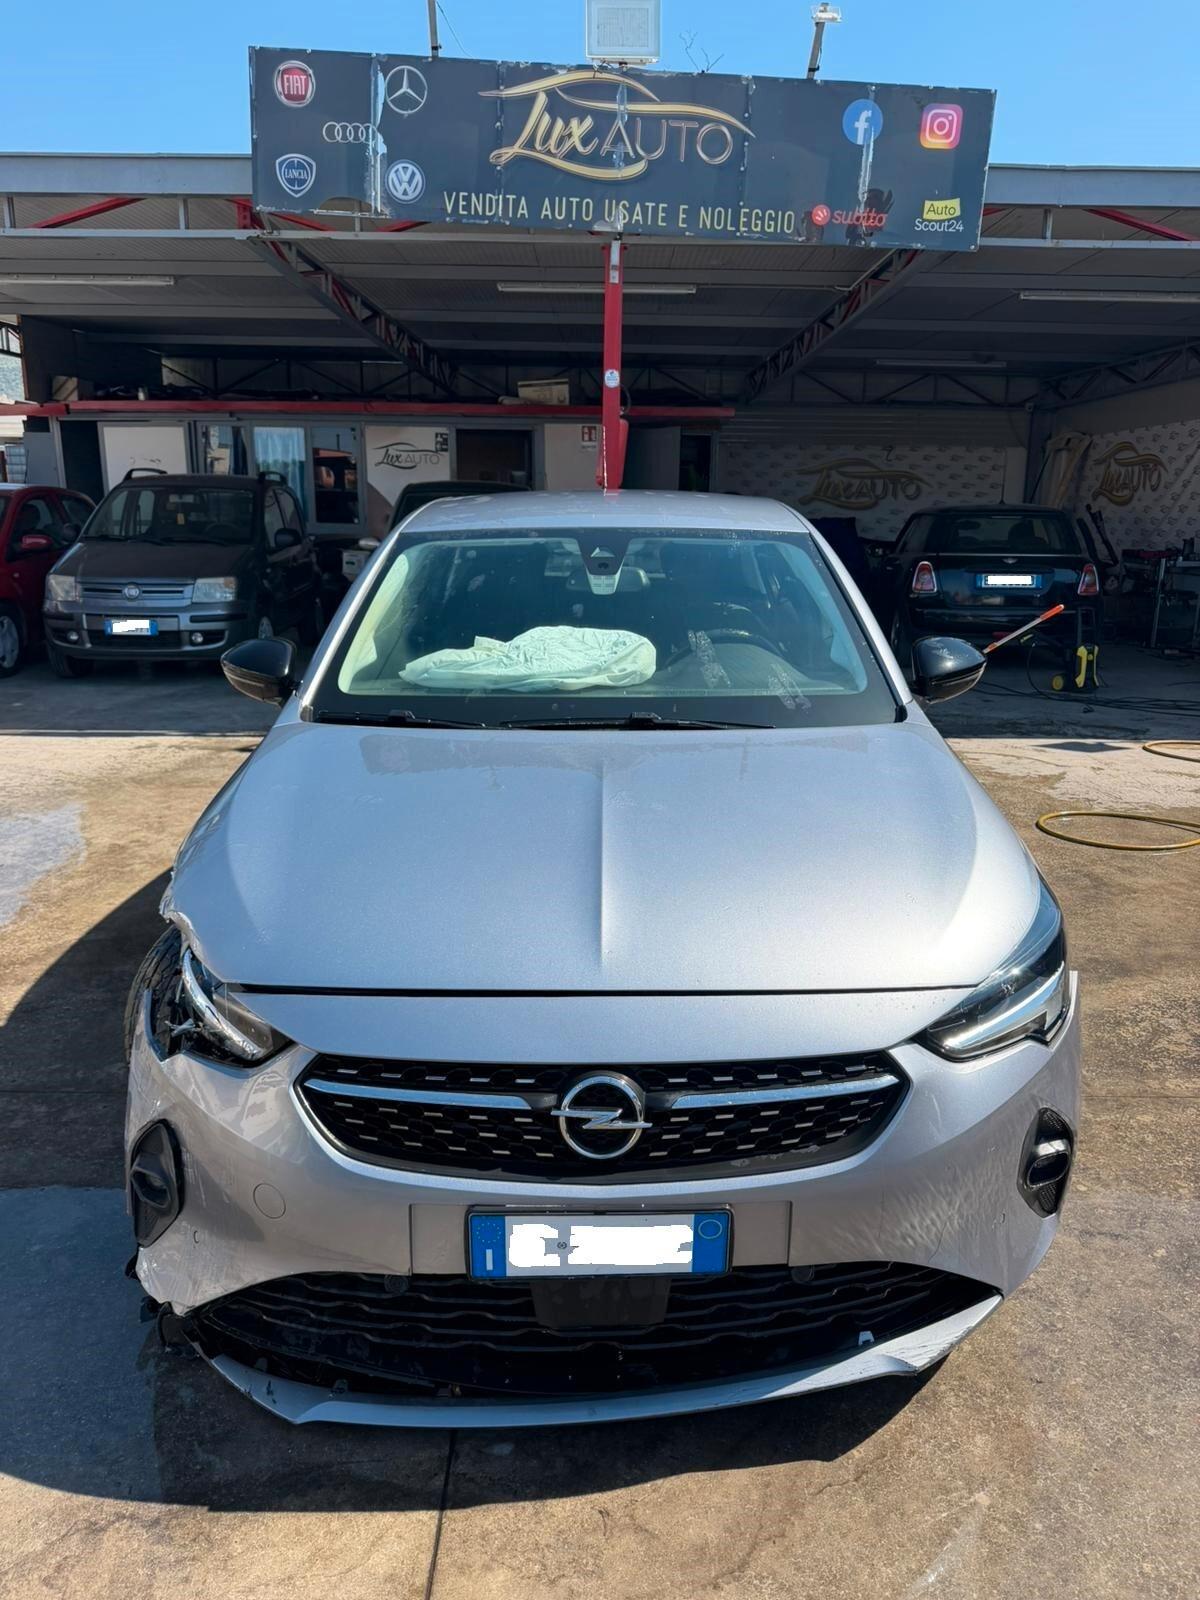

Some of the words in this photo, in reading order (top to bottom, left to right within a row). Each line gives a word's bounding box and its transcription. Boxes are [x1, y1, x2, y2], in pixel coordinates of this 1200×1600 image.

[284, 74, 307, 96] FIAT
[489, 90, 600, 166] Lux
[599, 117, 734, 165] AUTO
[284, 168, 308, 180] LANCIA
[443, 191, 529, 218] VENDITA
[540, 197, 594, 221] AUTO
[604, 199, 668, 226] USATE
[678, 205, 689, 228] E
[699, 207, 796, 234] NOLEGGIO
[926, 203, 957, 217] Auto
[914, 218, 964, 233] Scout24
